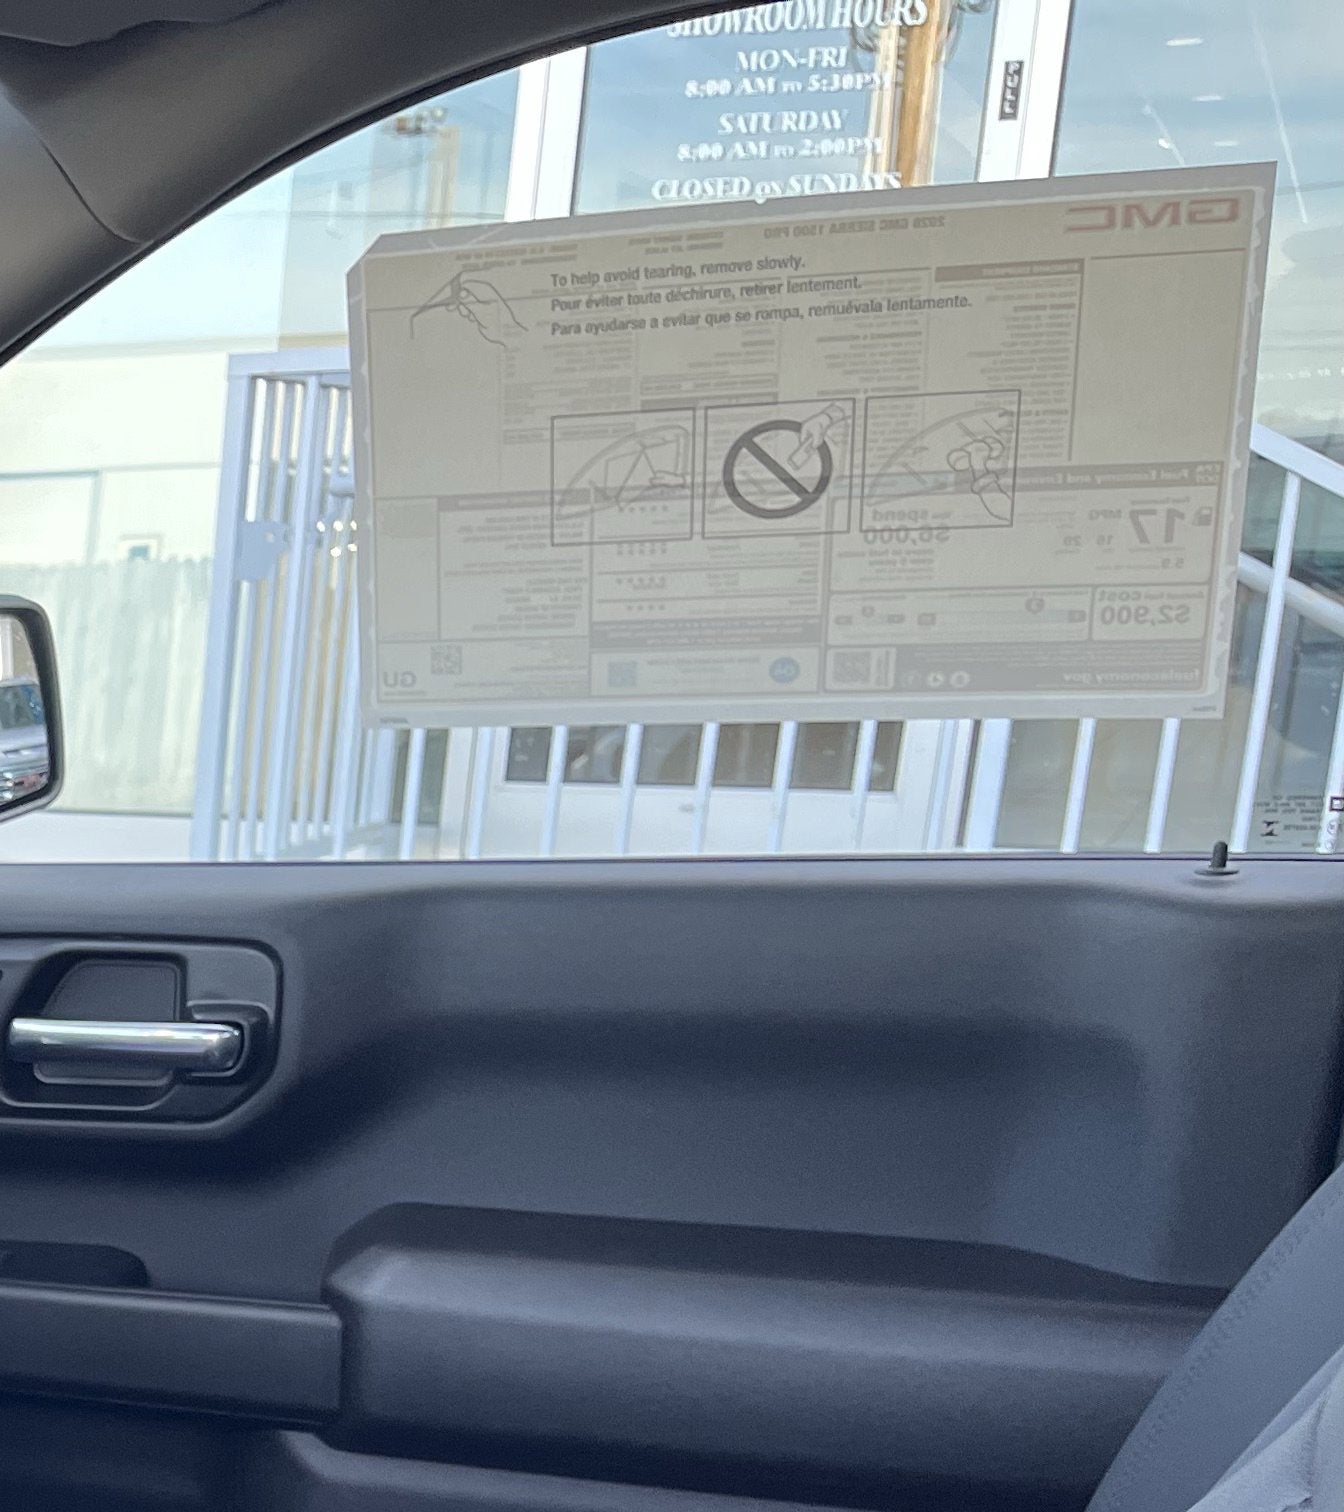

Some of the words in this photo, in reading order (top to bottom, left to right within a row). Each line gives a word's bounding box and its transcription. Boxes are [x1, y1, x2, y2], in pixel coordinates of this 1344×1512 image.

[735, 46, 849, 73] MON-FRI
[736, 76, 776, 96] AM
[717, 108, 849, 136] SATURDAY
[729, 139, 771, 160] AM
[650, 174, 752, 202] CLOSED
[787, 171, 904, 197] SUNDAYS
[550, 272, 570, 289] To
[570, 269, 601, 290] help
[603, 264, 641, 284] avoid
[643, 260, 698, 285] tearing,
[699, 257, 754, 276] remove
[755, 253, 807, 274] slowly.
[550, 294, 582, 313] Pour
[584, 290, 625, 310] éviter
[626, 288, 662, 308] toute
[739, 279, 784, 298] retirer
[785, 274, 864, 294] lentement.
[550, 318, 582, 337] Para
[584, 314, 647, 338] ayudarse
[649, 317, 660, 330] a
[662, 310, 701, 330] evitar
[703, 310, 732, 328] que
[734, 309, 752, 323] se
[754, 304, 806, 326] rompa,
[885, 293, 974, 314] lentamente.
